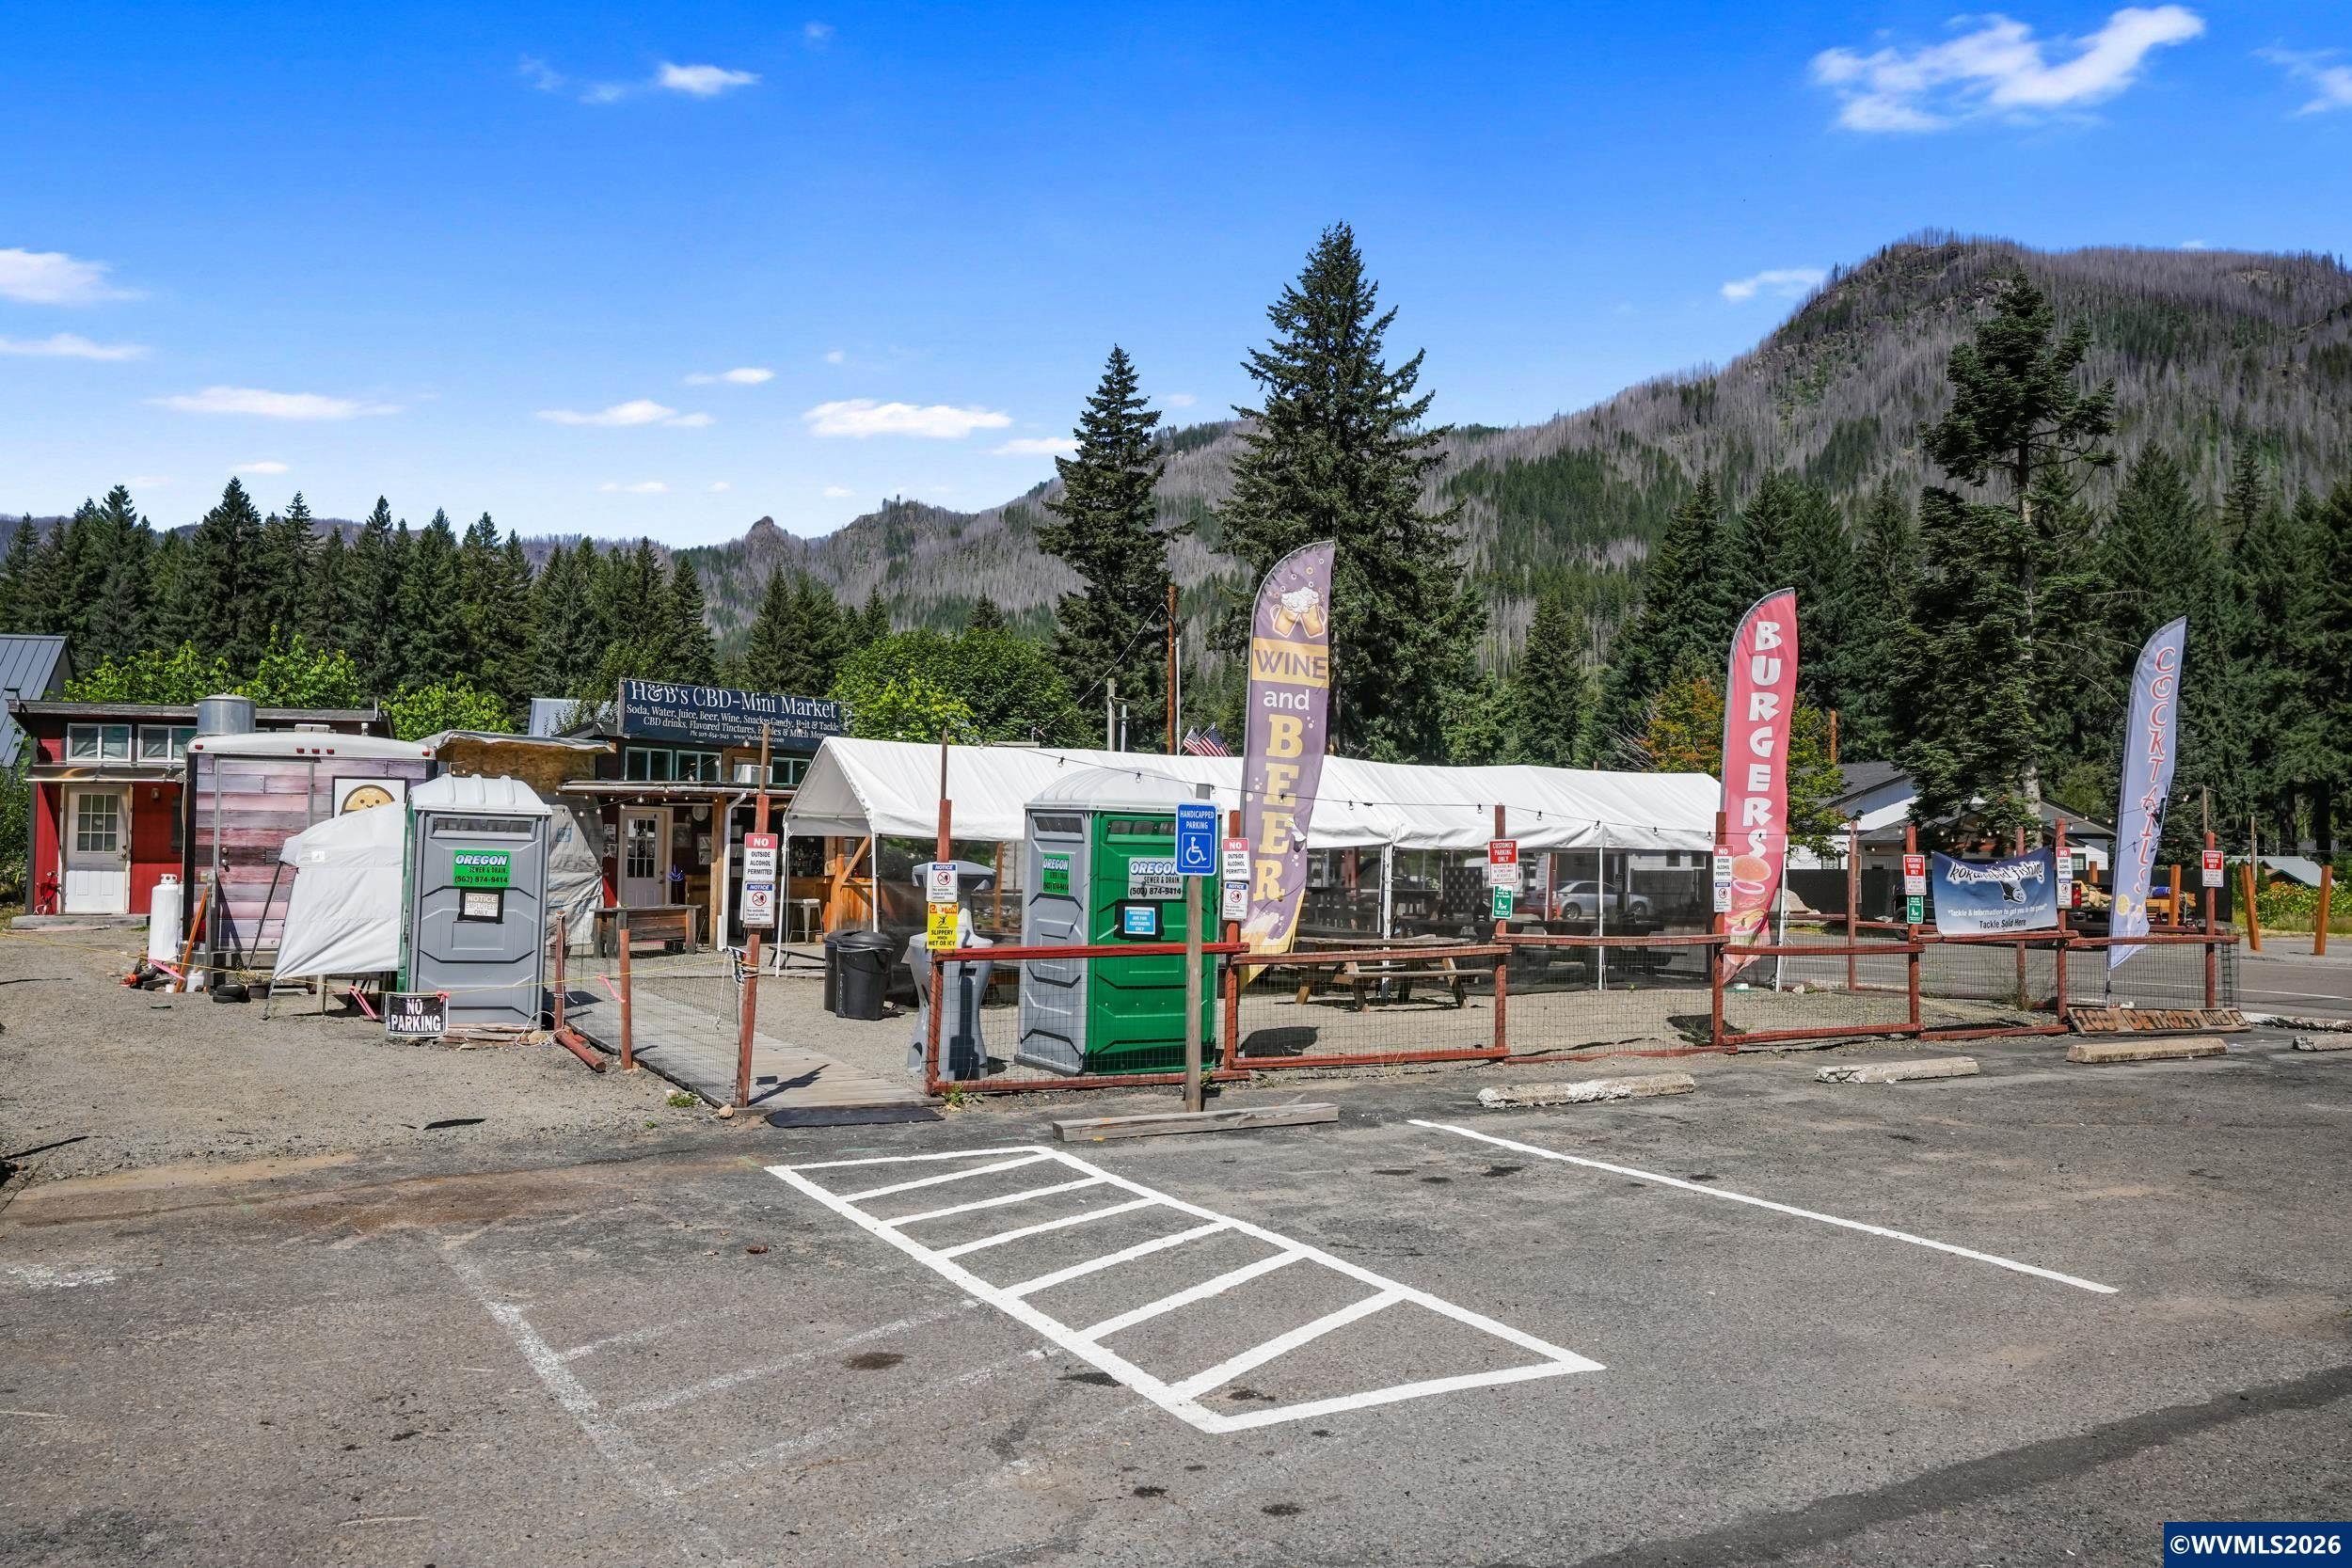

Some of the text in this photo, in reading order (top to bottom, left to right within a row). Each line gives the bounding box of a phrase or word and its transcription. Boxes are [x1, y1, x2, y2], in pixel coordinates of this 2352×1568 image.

[1254, 649, 1327, 680] WINE
[630, 680, 836, 719] H&B's CBD-Mini Market
[1263, 689, 1310, 711] and
[626, 704, 650, 716] Soda,
[651, 705, 676, 718] Water,
[676, 708, 698, 721] Juice,
[699, 710, 720, 721] Beer,
[721, 712, 742, 723] Wine,
[771, 717, 794, 729] Candy,
[811, 721, 818, 729] &
[818, 721, 839, 732] Tackle
[644, 716, 661, 726] CBD
[662, 718, 688, 729] drinks,
[689, 720, 721, 732] Flavored
[721, 721, 756, 735] Tinctures,
[782, 728, 789, 736] &
[1742, 621, 1782, 859] BURGERS
[1179, 810, 1215, 819] HANDICAPPED
[1252, 713, 1303, 903] BEER
[1185, 820, 1209, 830] PARKING
[753, 837, 770, 847] NO
[1229, 841, 1242, 850] NO
[454, 853, 509, 866] OREGON
[1043, 857, 1070, 872] OREGON
[1143, 876, 1160, 884] SEWER
[467, 894, 498, 903] NOTICE
[1129, 887, 1182, 896] (503) 874-9414
[1973, 908, 2003, 917] information
[1979, 918, 2026, 929] Tackle Sold Here
[406, 998, 423, 1015] NO
[390, 1014, 441, 1032] PARKING
[2120, 1008, 2203, 1031] DETROIT
